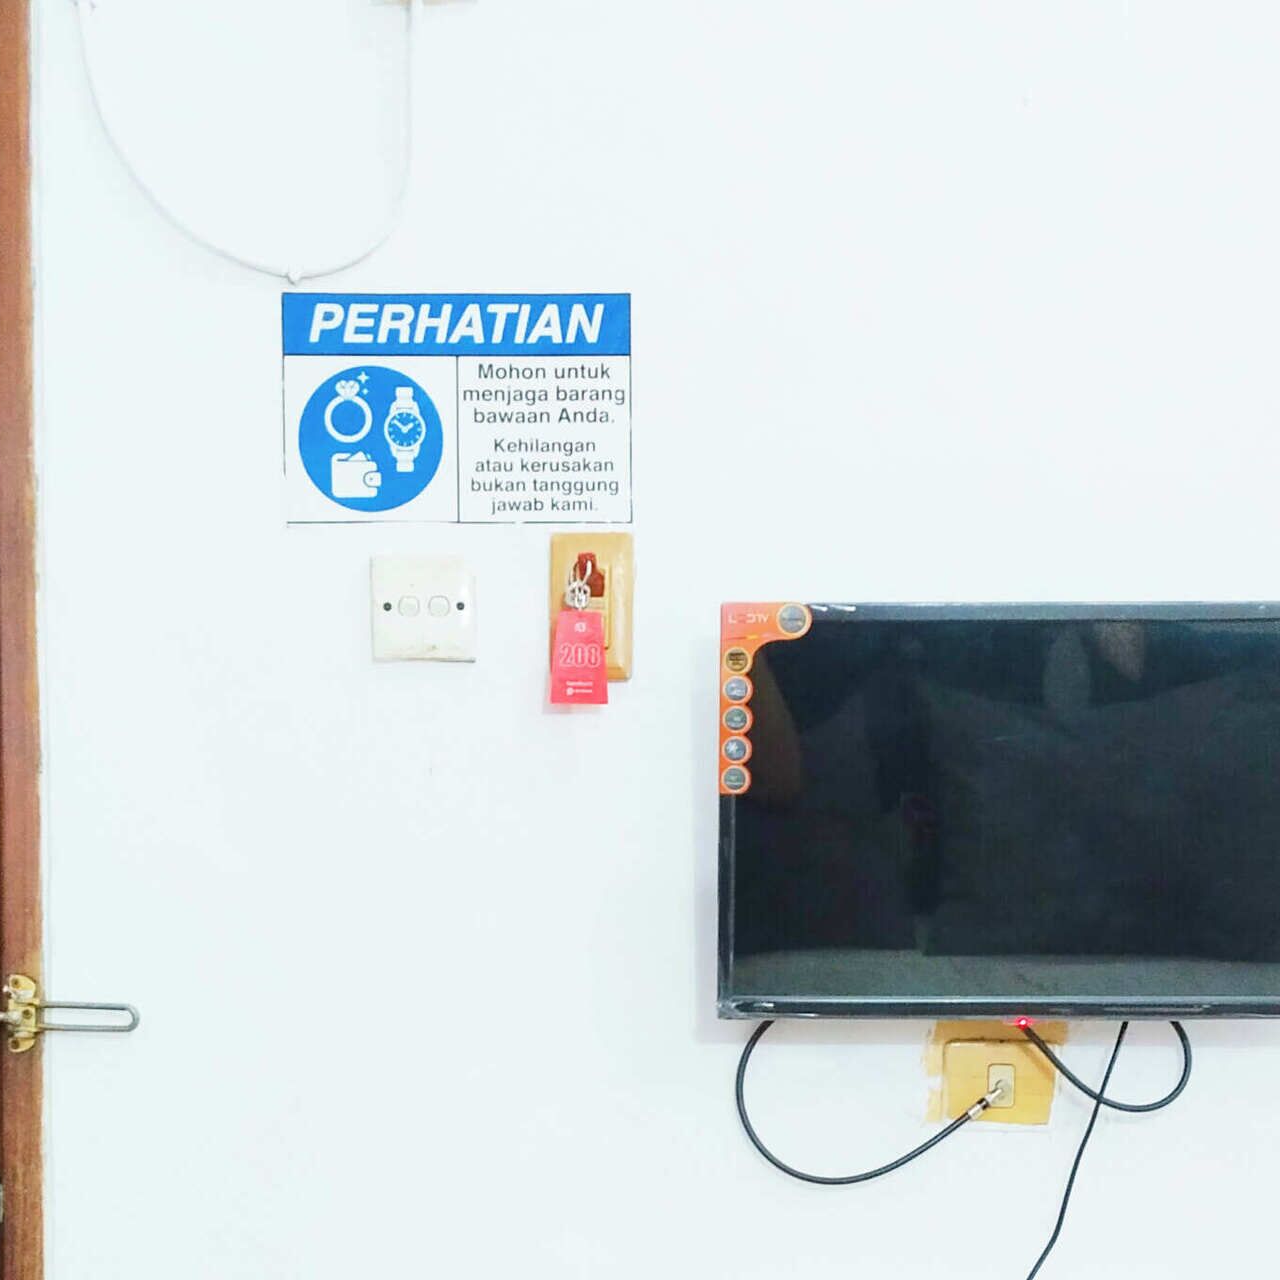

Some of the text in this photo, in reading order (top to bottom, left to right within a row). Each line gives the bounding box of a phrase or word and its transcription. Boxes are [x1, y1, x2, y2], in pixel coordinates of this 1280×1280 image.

[308, 302, 605, 344] PERHATIAN
[477, 363, 611, 379] Mohon untuk
[462, 385, 626, 406] menjaga barang
[473, 407, 616, 424] bawaan Anda.
[493, 438, 597, 457] Kehilangan
[474, 458, 615, 473] atau kerusakan
[470, 477, 620, 496] bukan tanggung
[490, 497, 599, 515] jawab kami.
